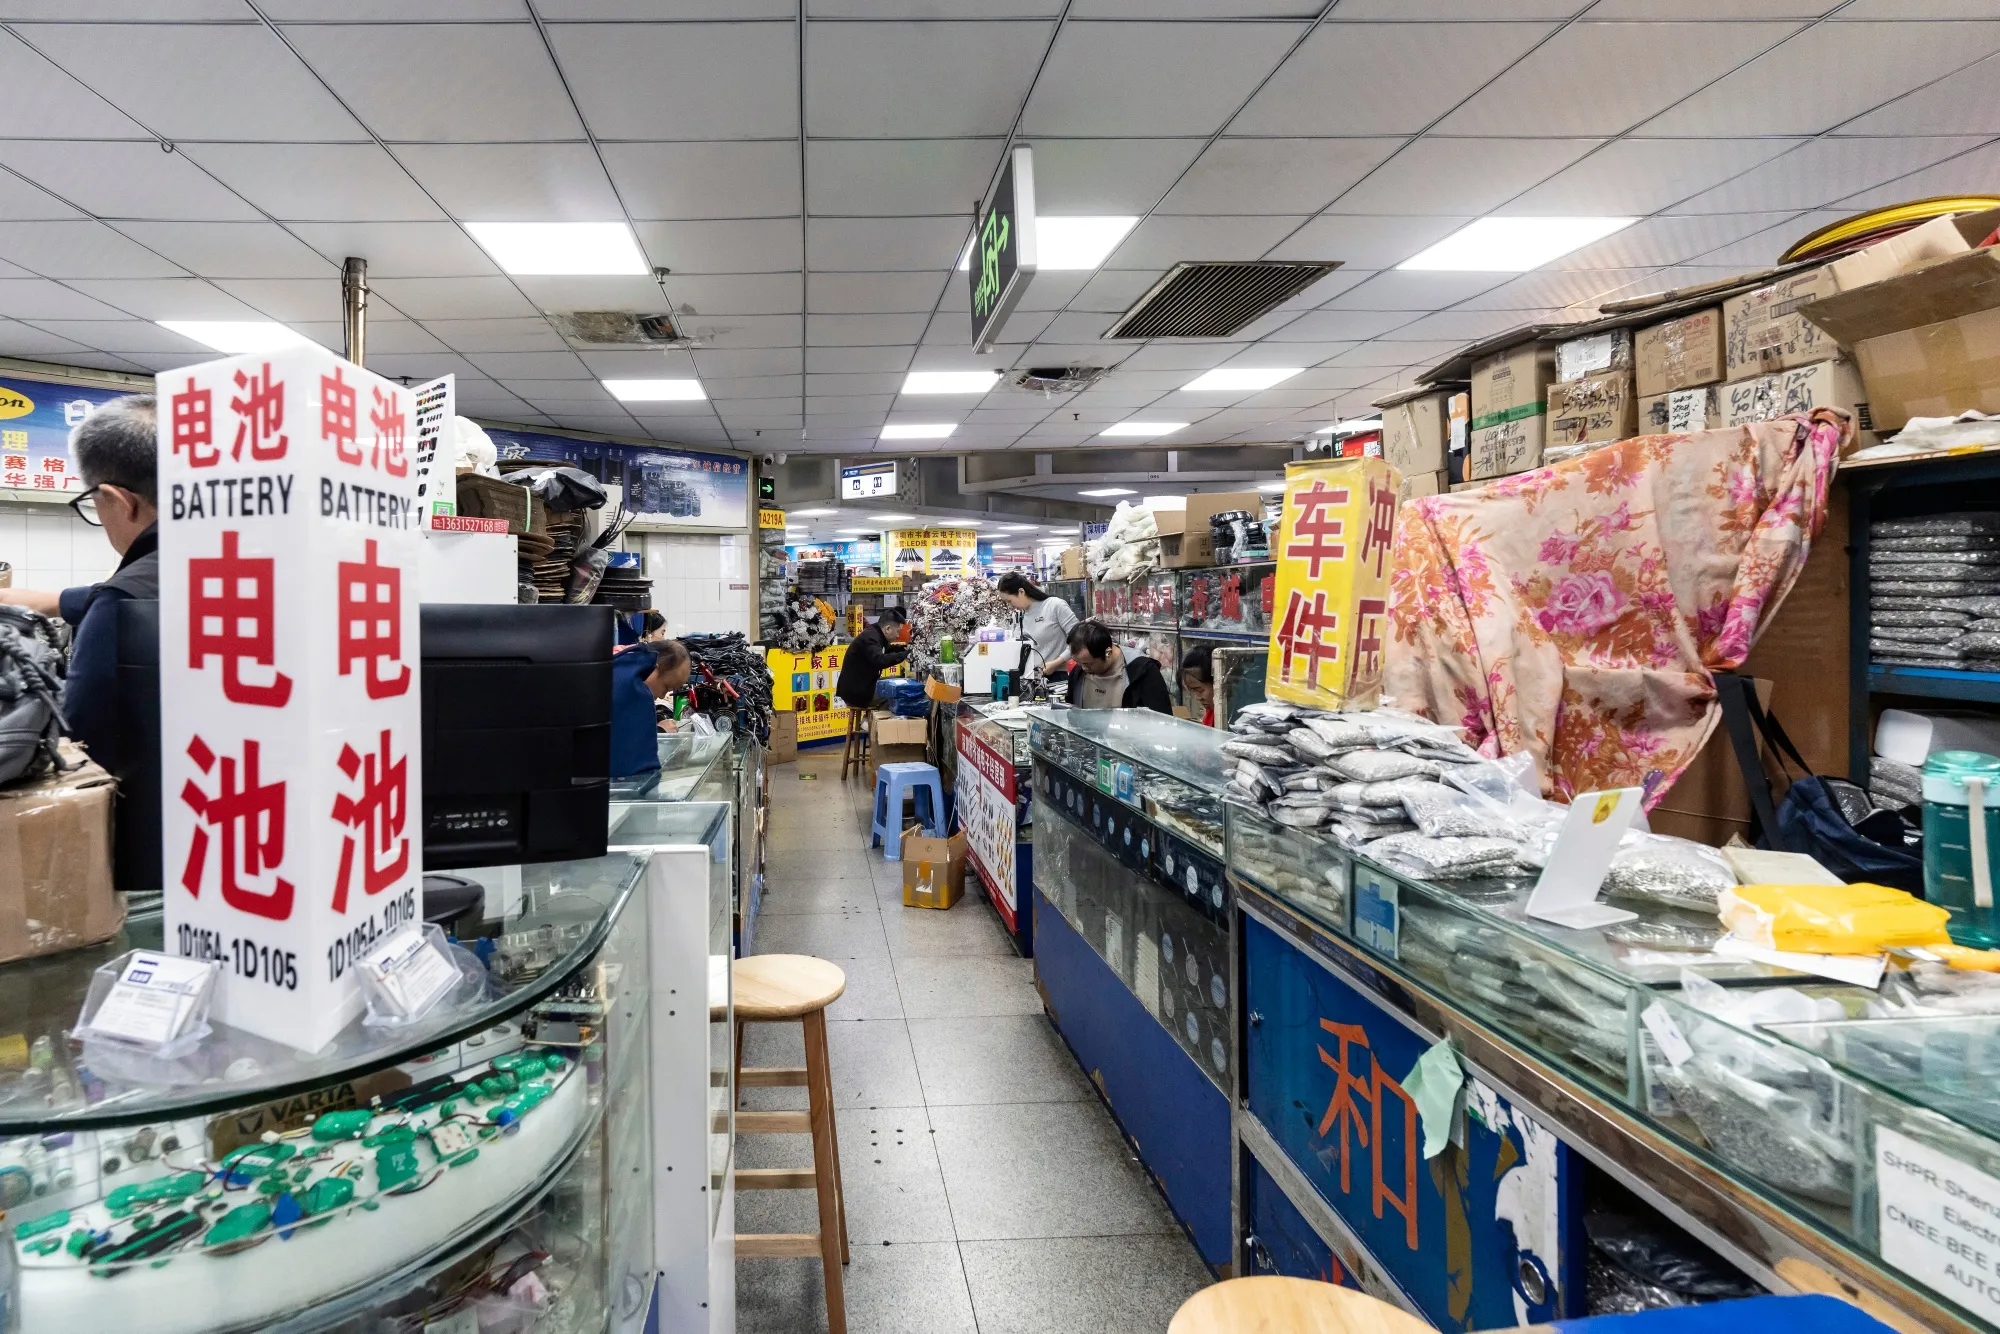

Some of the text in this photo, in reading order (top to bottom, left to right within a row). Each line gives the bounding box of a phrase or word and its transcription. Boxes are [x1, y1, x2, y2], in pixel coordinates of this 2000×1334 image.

[172, 362, 288, 468] 电池
[320, 366, 408, 478] 电池
[171, 473, 294, 521] BATTERY
[320, 476, 411, 530] BATTERY
[1277, 480, 1349, 691] 车件
[1351, 469, 1396, 698] 冲压
[793, 654, 840, 671] 厂家直
[269, 1083, 357, 1122] VARTA
[1316, 1016, 1419, 1251] 和
